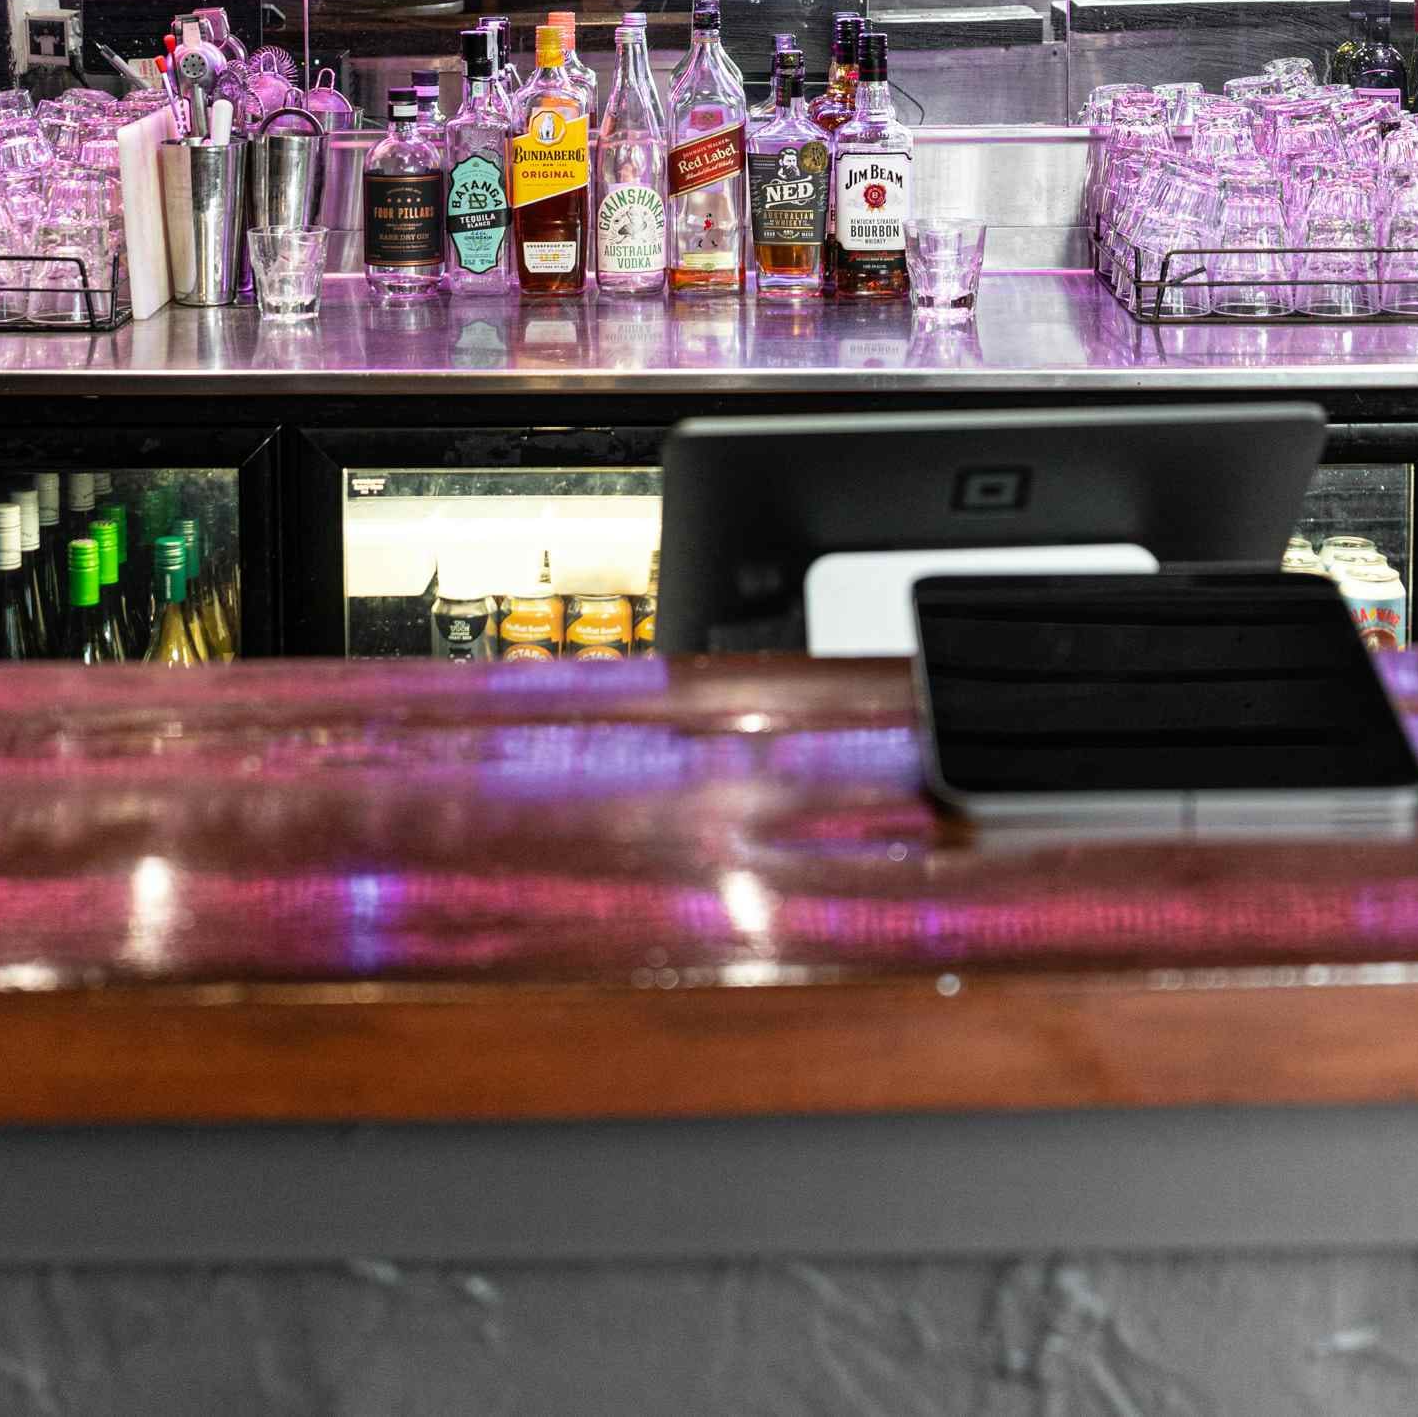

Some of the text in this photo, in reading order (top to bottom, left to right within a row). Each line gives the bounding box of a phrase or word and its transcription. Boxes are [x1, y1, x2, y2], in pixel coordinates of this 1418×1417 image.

[512, 144, 586, 164] BUNDABERG
[678, 142, 737, 174] Red Label
[521, 170, 576, 179] ORIGINAL
[845, 164, 903, 190] JIM BEAM
[451, 179, 503, 209] BATANGA
[765, 182, 815, 203] NED
[598, 188, 664, 231] GRAINSHAKER
[763, 211, 814, 219] AUSTRALIAN
[460, 213, 496, 224] TEQUILA
[466, 220, 491, 229] BLANCO
[850, 225, 900, 238] BOURBON
[604, 243, 662, 257] AUSTRALIAN
[617, 257, 651, 269] VODKA
